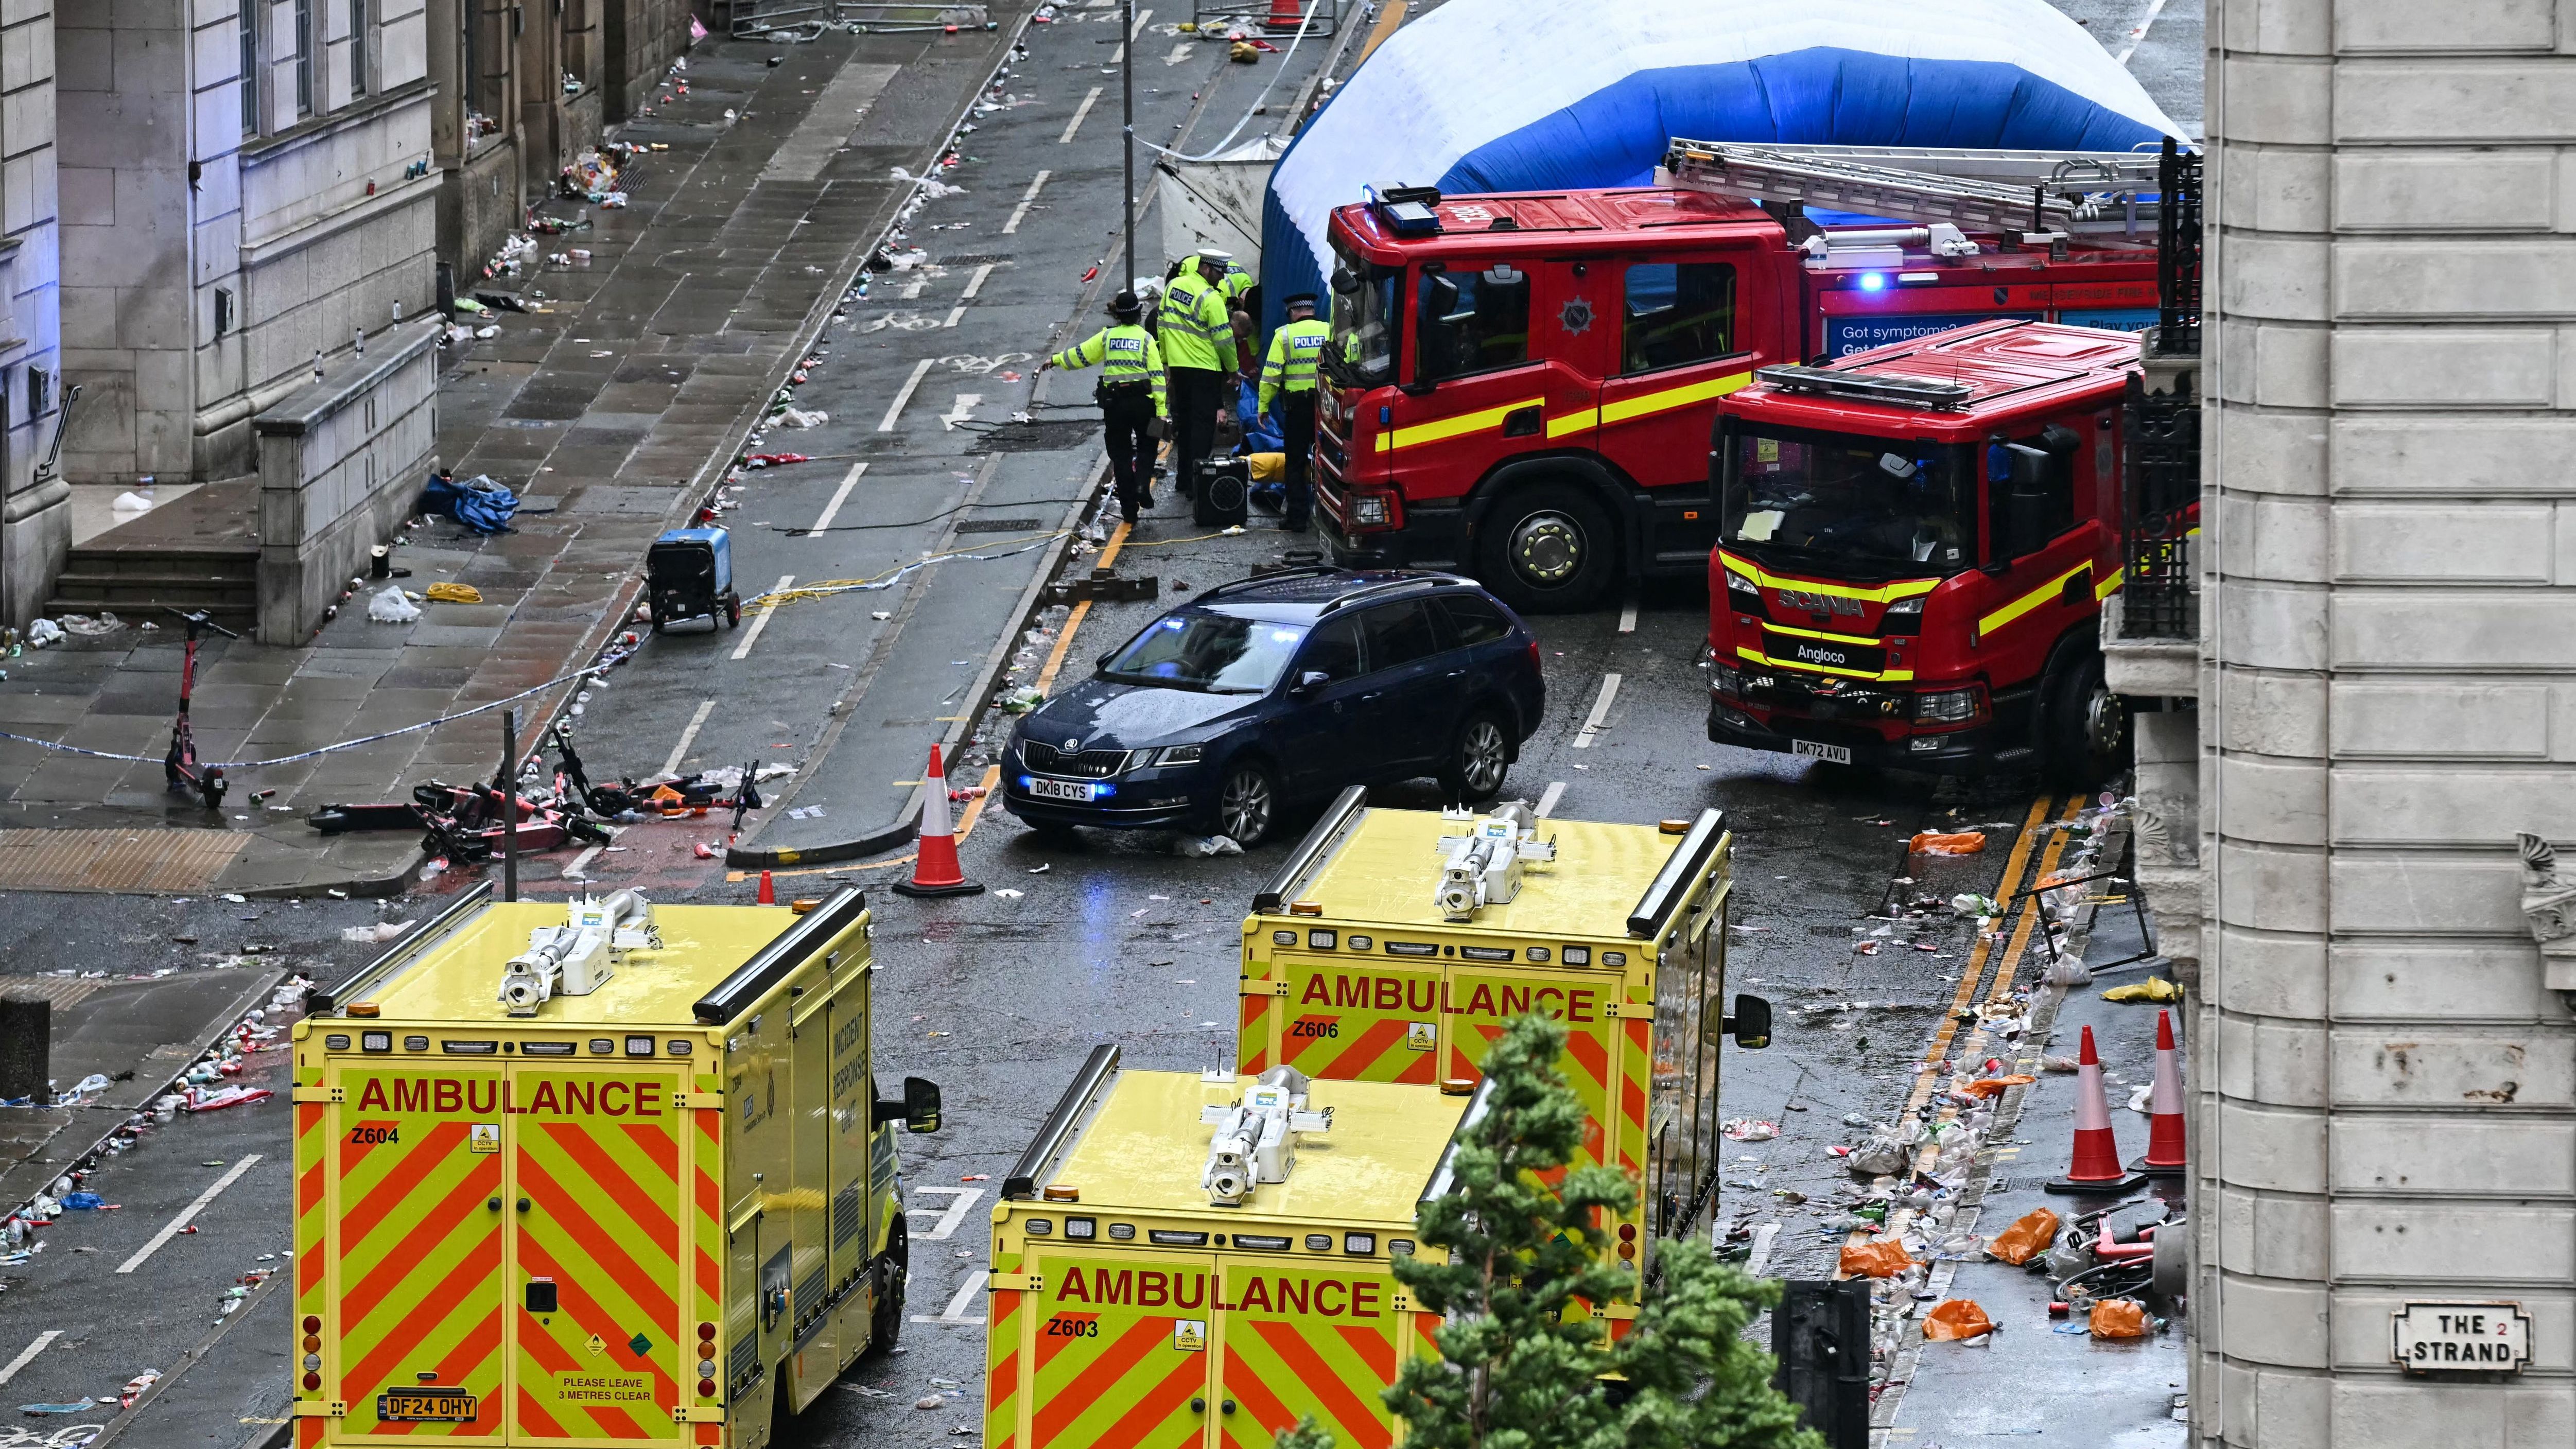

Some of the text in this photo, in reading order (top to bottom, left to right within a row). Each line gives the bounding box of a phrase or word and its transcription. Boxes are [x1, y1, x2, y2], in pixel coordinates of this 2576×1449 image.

[1171, 288, 1193, 306] POLICE
[1294, 337, 1325, 347] POLICE
[1842, 327, 1869, 338] Got
[1110, 339, 1140, 350] POLICE
[1842, 344, 1870, 356] Get
[1779, 589, 1865, 618] SCANIA
[1797, 644, 1845, 664] Angloco
[1796, 741, 1847, 761] DK72 AVU
[1036, 780, 1086, 799] DK18 CYS
[1300, 973, 1594, 1023] AMBULANCE
[834, 1011, 863, 1059] INCIDENT
[1292, 1020, 1338, 1038] Z606
[357, 1077, 662, 1116] AMBULANCE
[842, 1099, 856, 1134] UNIT
[352, 1127, 399, 1144] Z604
[1056, 1267, 1381, 1318] AMBULANCE
[1047, 1318, 1098, 1337] Z603
[2438, 1315, 2485, 1334] THE
[2497, 1323, 2507, 1336] 2
[2414, 1341, 2510, 1362] STRAND
[564, 1378, 642, 1388] PLEASE LEAVE
[559, 1391, 650, 1401] 3 METRES CLEAR
[389, 1399, 473, 1415] DF24 OHY
